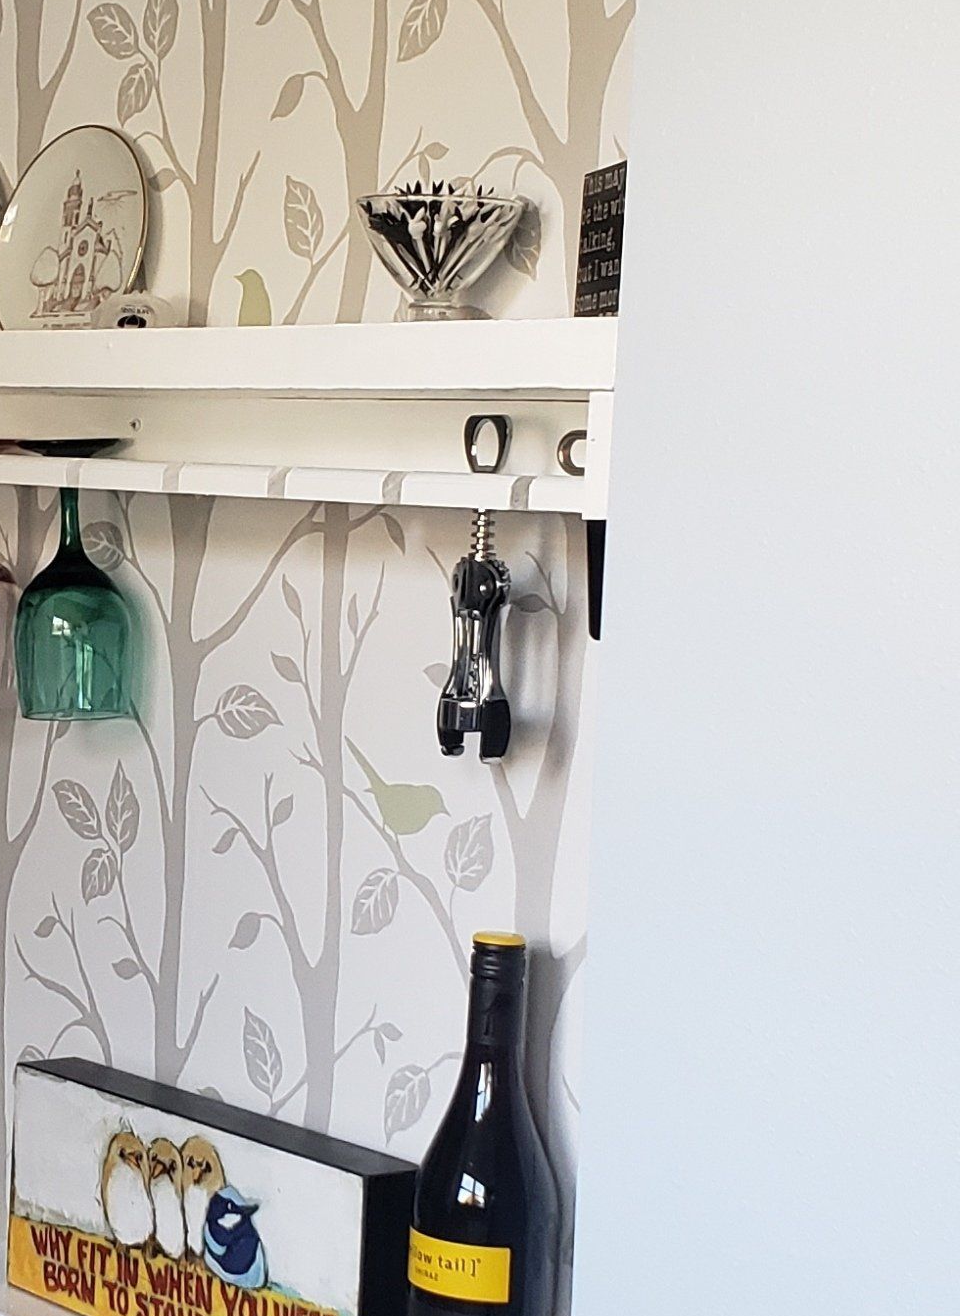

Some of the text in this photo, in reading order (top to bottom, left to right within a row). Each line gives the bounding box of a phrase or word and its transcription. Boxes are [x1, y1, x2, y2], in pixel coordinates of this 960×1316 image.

[580, 227, 616, 255] alking,
[29, 1224, 71, 1266] WHY
[77, 1238, 111, 1277] FIT
[115, 1249, 139, 1288] IN
[146, 1261, 213, 1315] WHEN
[42, 1260, 96, 1307] BORN
[103, 1279, 130, 1316] TO
